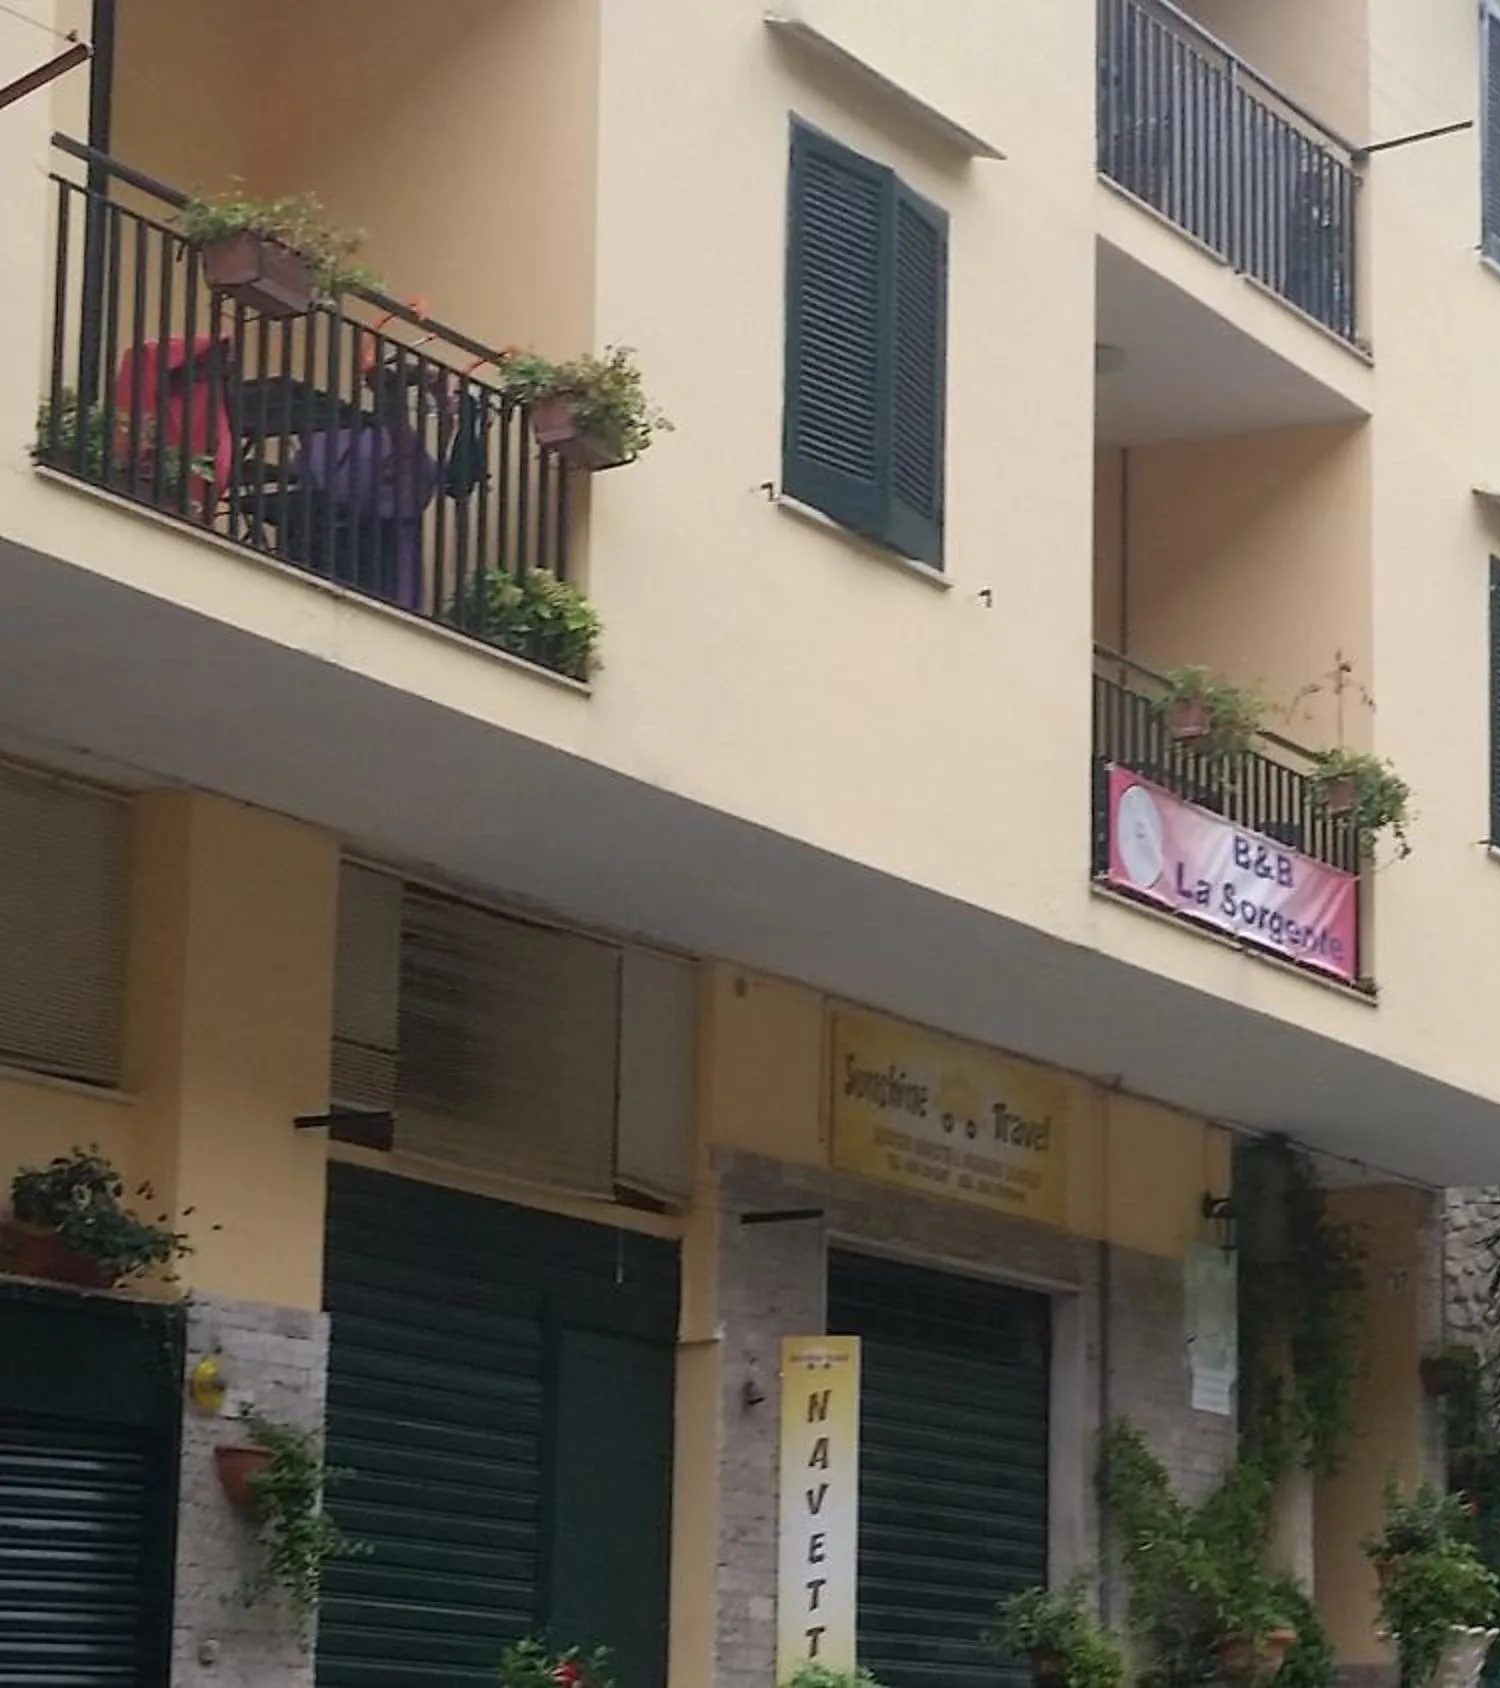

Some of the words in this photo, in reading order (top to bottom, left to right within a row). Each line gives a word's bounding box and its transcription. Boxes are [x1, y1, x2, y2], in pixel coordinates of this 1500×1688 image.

[1233, 835, 1293, 888] B&B
[1176, 861, 1211, 908] La
[1219, 882, 1344, 960] Sorgente
[992, 1102, 1052, 1152] Travel
